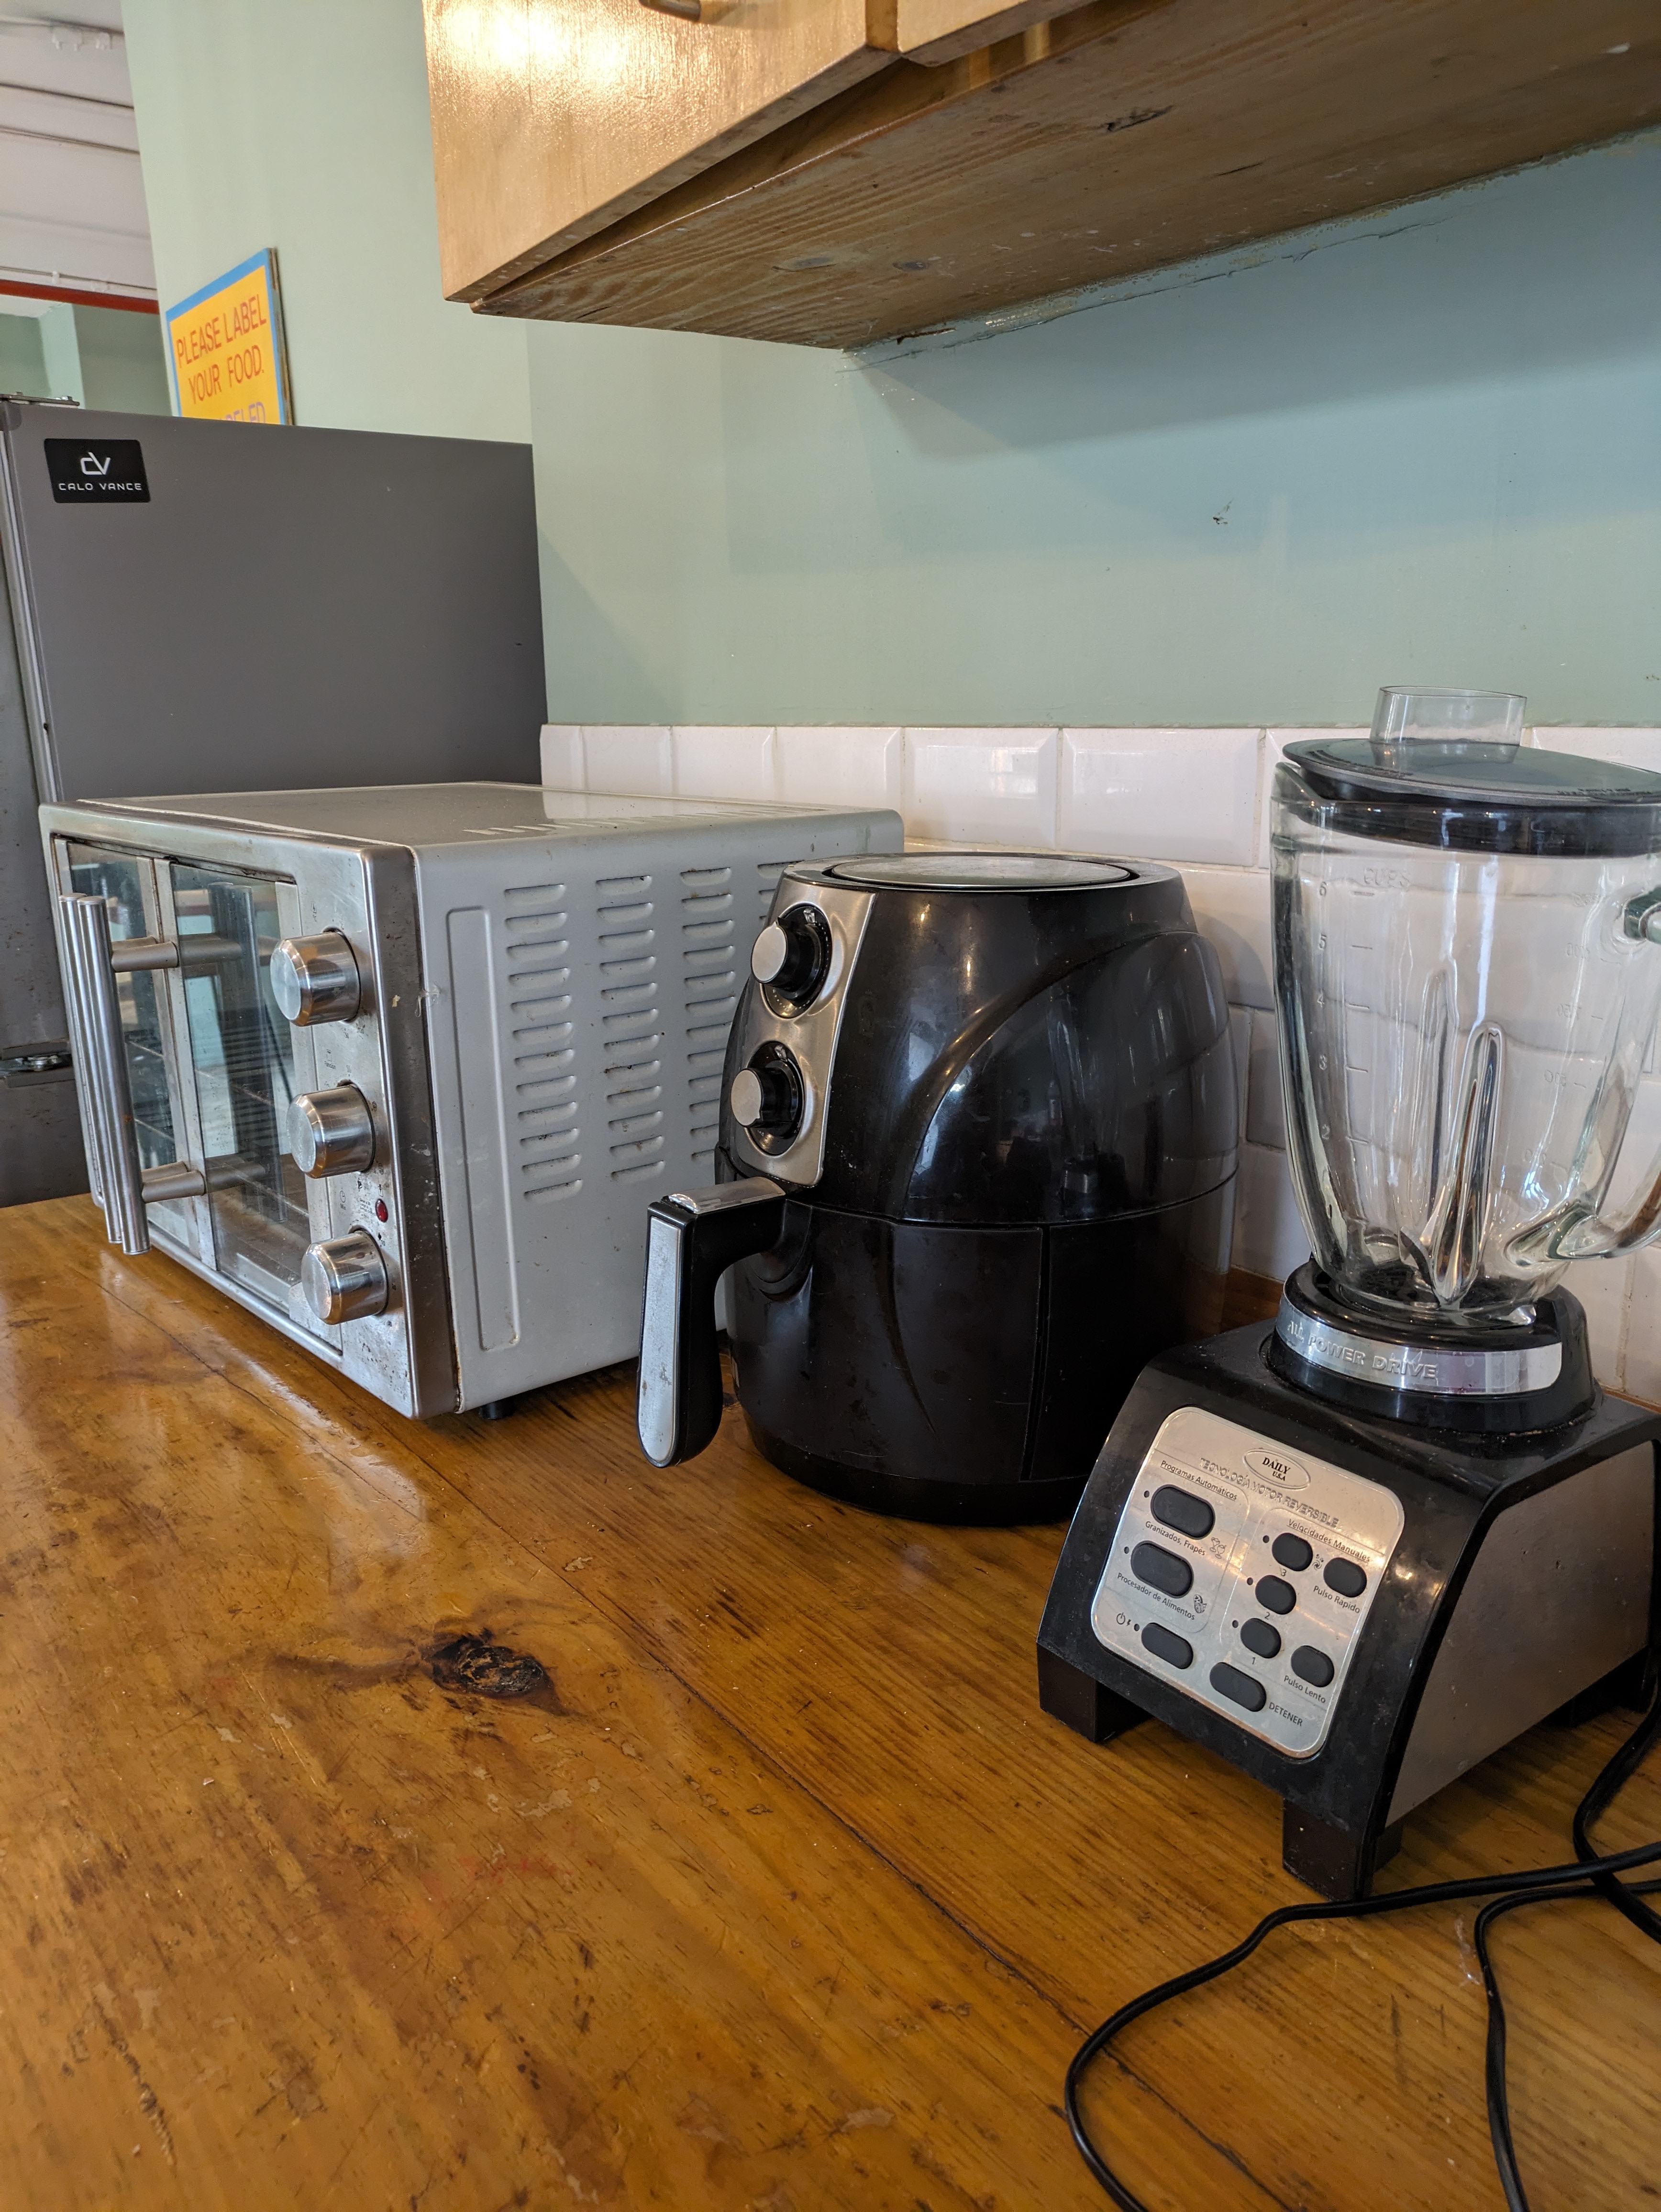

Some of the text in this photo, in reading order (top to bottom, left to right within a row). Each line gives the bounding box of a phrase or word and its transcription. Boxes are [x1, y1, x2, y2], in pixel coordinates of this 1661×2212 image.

[176, 294, 266, 368] PLEASE LABEL
[188, 345, 265, 404] YOUR FOOD.
[1319, 881, 1328, 896] 6
[1318, 934, 1327, 950] 5
[1317, 993, 1325, 1007] 4
[1319, 1055, 1327, 1071] 3
[1321, 1124, 1330, 1140] 2
[1308, 1333, 1366, 1365] POWER
[1372, 1355, 1437, 1379] DRIVE
[1262, 1457, 1291, 1474] DAILY
[1161, 1460, 1238, 1500] Programas Automáticos
[1199, 1457, 1339, 1528] TECNOLOGÍA MOTOR REVERSIBLE
[1145, 1521, 1206, 1556] Granizados, Frapés
[1288, 1519, 1371, 1562] Velocidades Manuales
[1280, 1569, 1287, 1577] 3
[1117, 1572, 1196, 1620] Procesador de Alimentos
[1313, 1585, 1360, 1614] Pulso Rápido
[1264, 1611, 1271, 1620] 2
[1251, 1657, 1256, 1665] 1
[1284, 1675, 1326, 1703] Pulso Lento
[1269, 1702, 1303, 1726] DETENER
